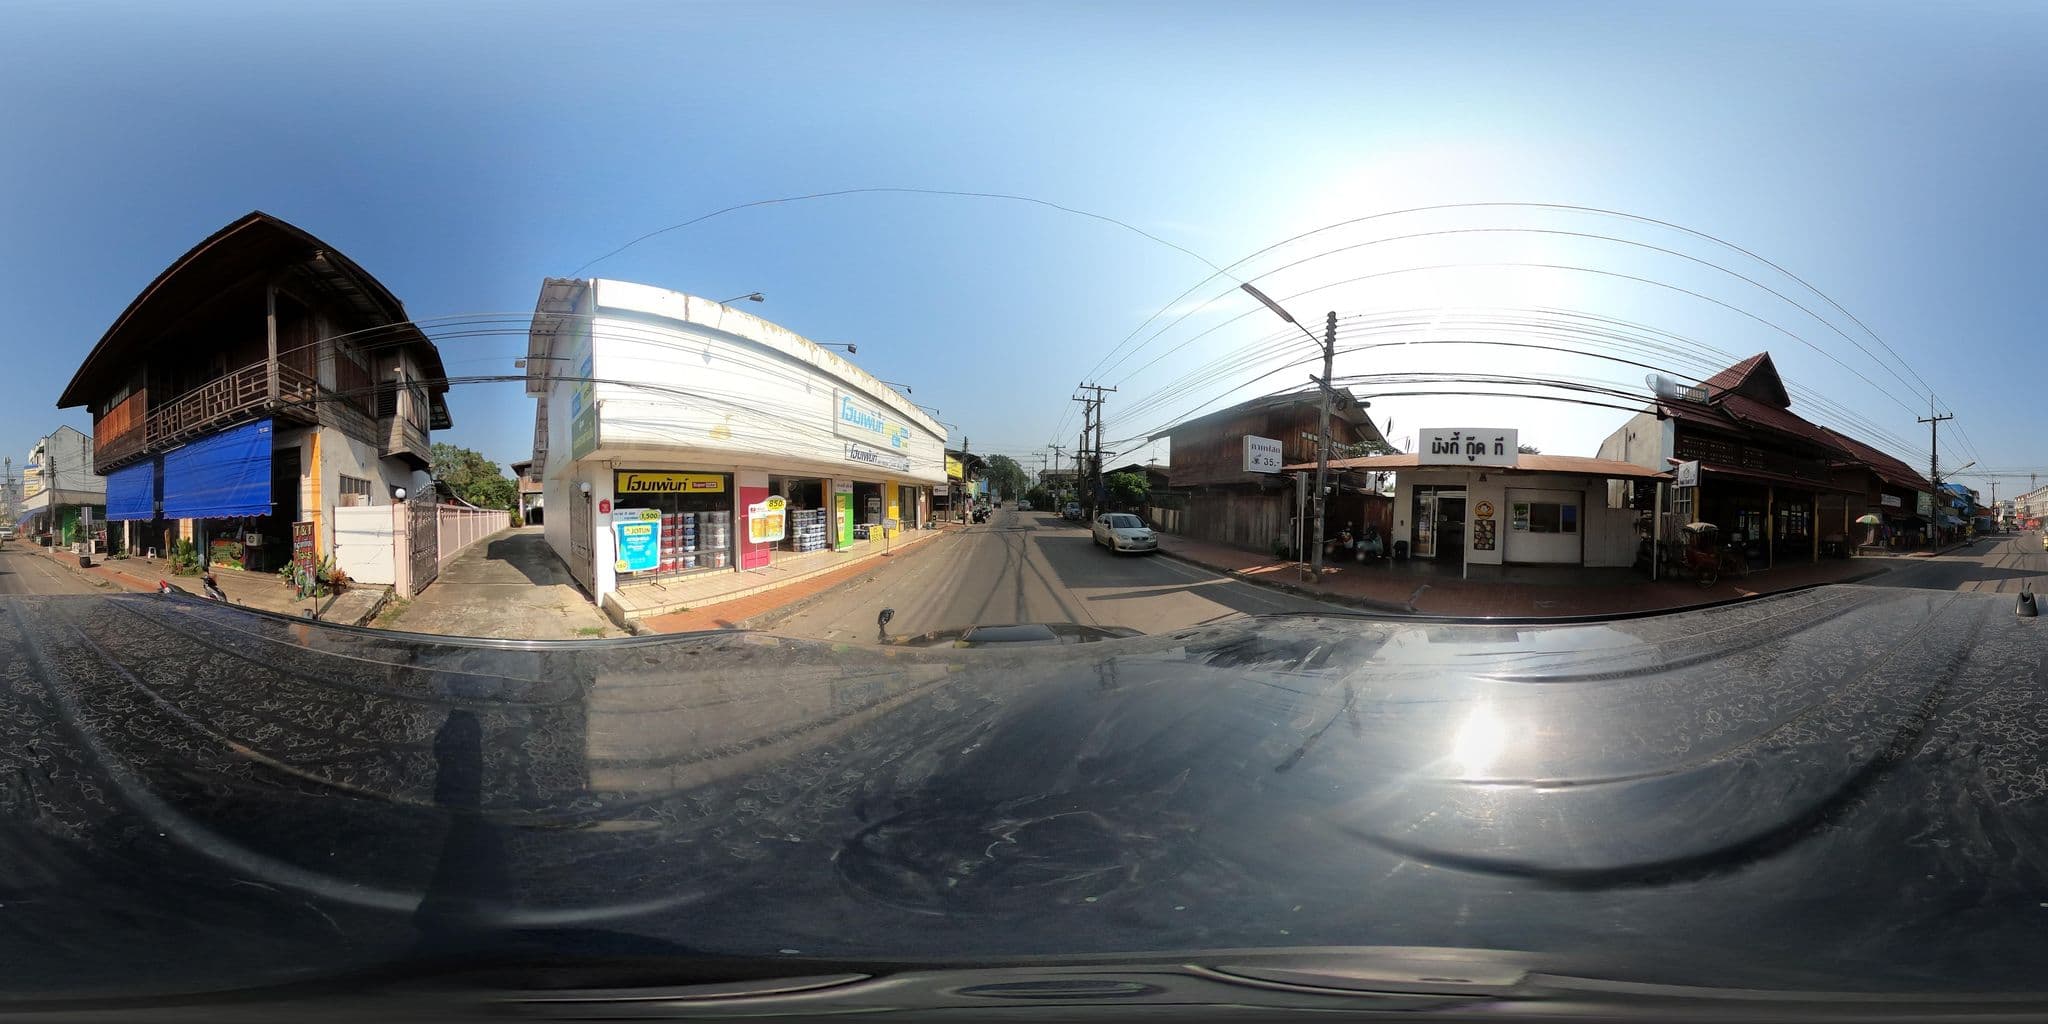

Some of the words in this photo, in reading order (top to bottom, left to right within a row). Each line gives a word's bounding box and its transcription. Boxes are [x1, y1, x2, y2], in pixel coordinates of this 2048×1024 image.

[1431, 431, 1460, 455] มังกี้
[1494, 436, 1504, 456] ที
[768, 499, 782, 508] 850
